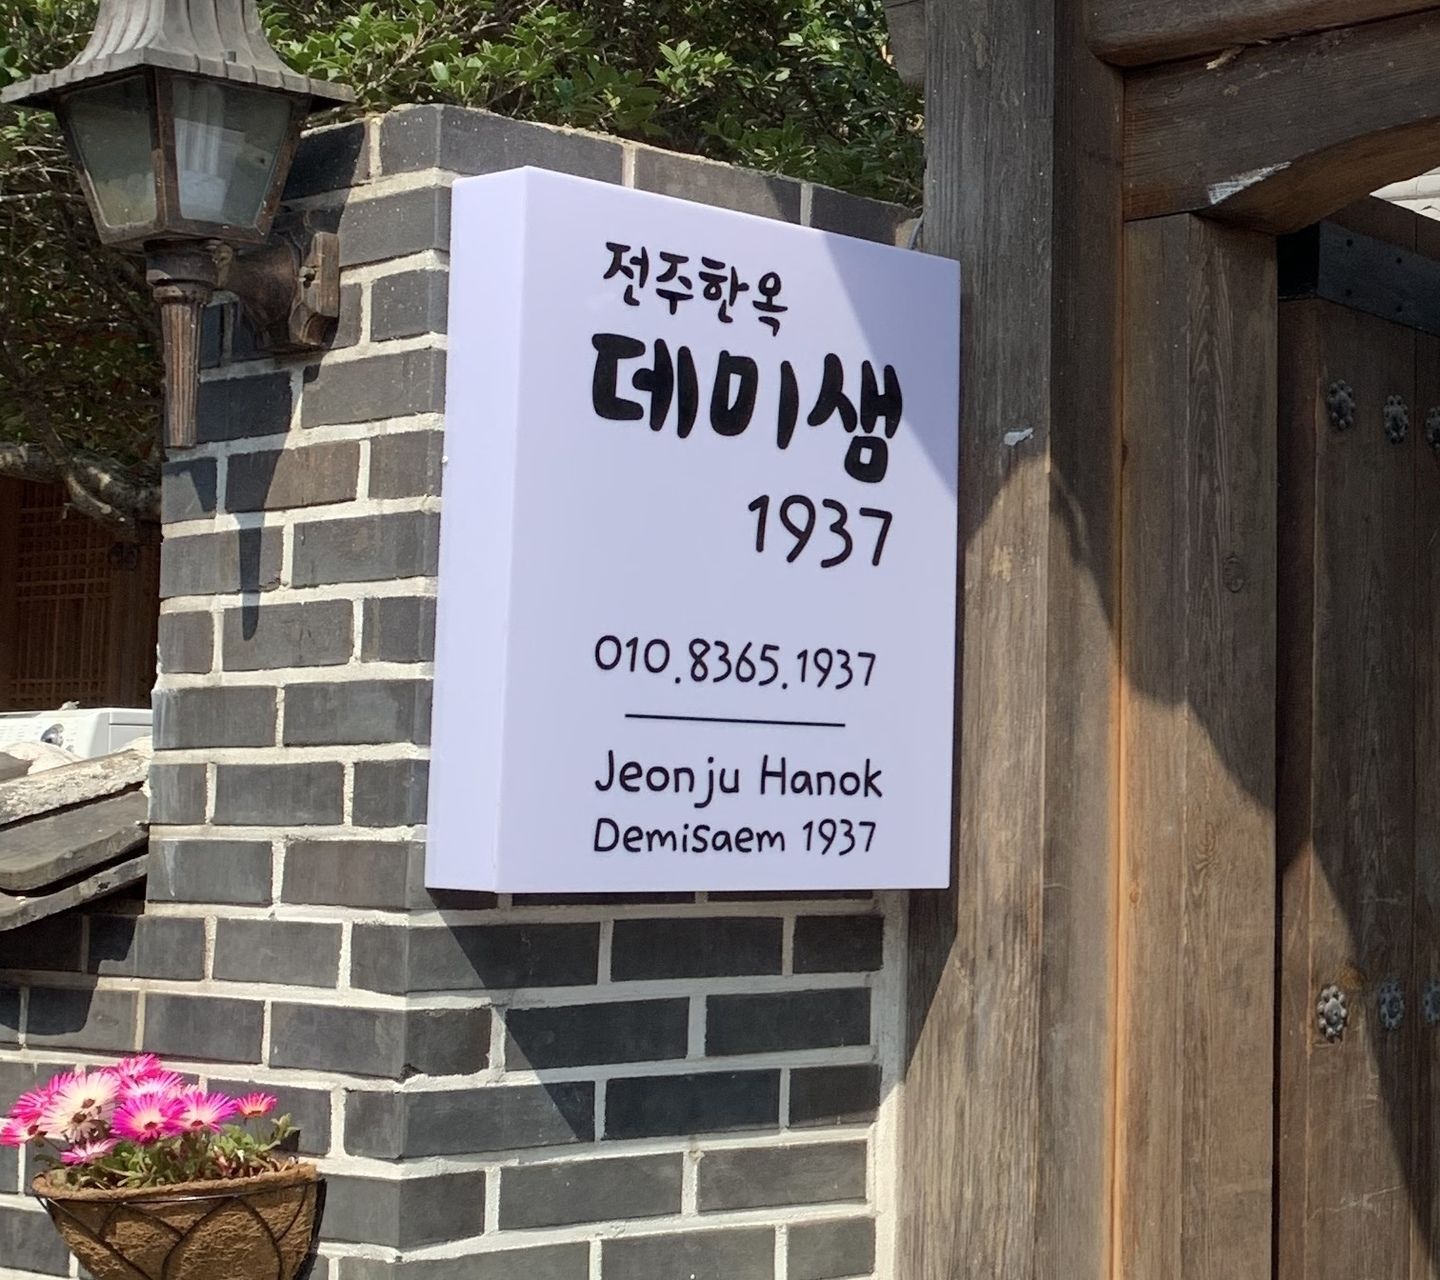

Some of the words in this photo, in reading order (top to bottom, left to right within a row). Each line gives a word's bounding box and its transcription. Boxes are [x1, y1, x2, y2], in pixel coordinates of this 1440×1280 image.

[602, 241, 789, 337] 전주한옥
[590, 332, 903, 485] 데미샘
[747, 493, 894, 569] 1937
[594, 634, 878, 690] 010.8365.1937
[594, 749, 740, 809] Jeonju
[759, 753, 884, 799] Hanok
[801, 818, 878, 856] 1937
